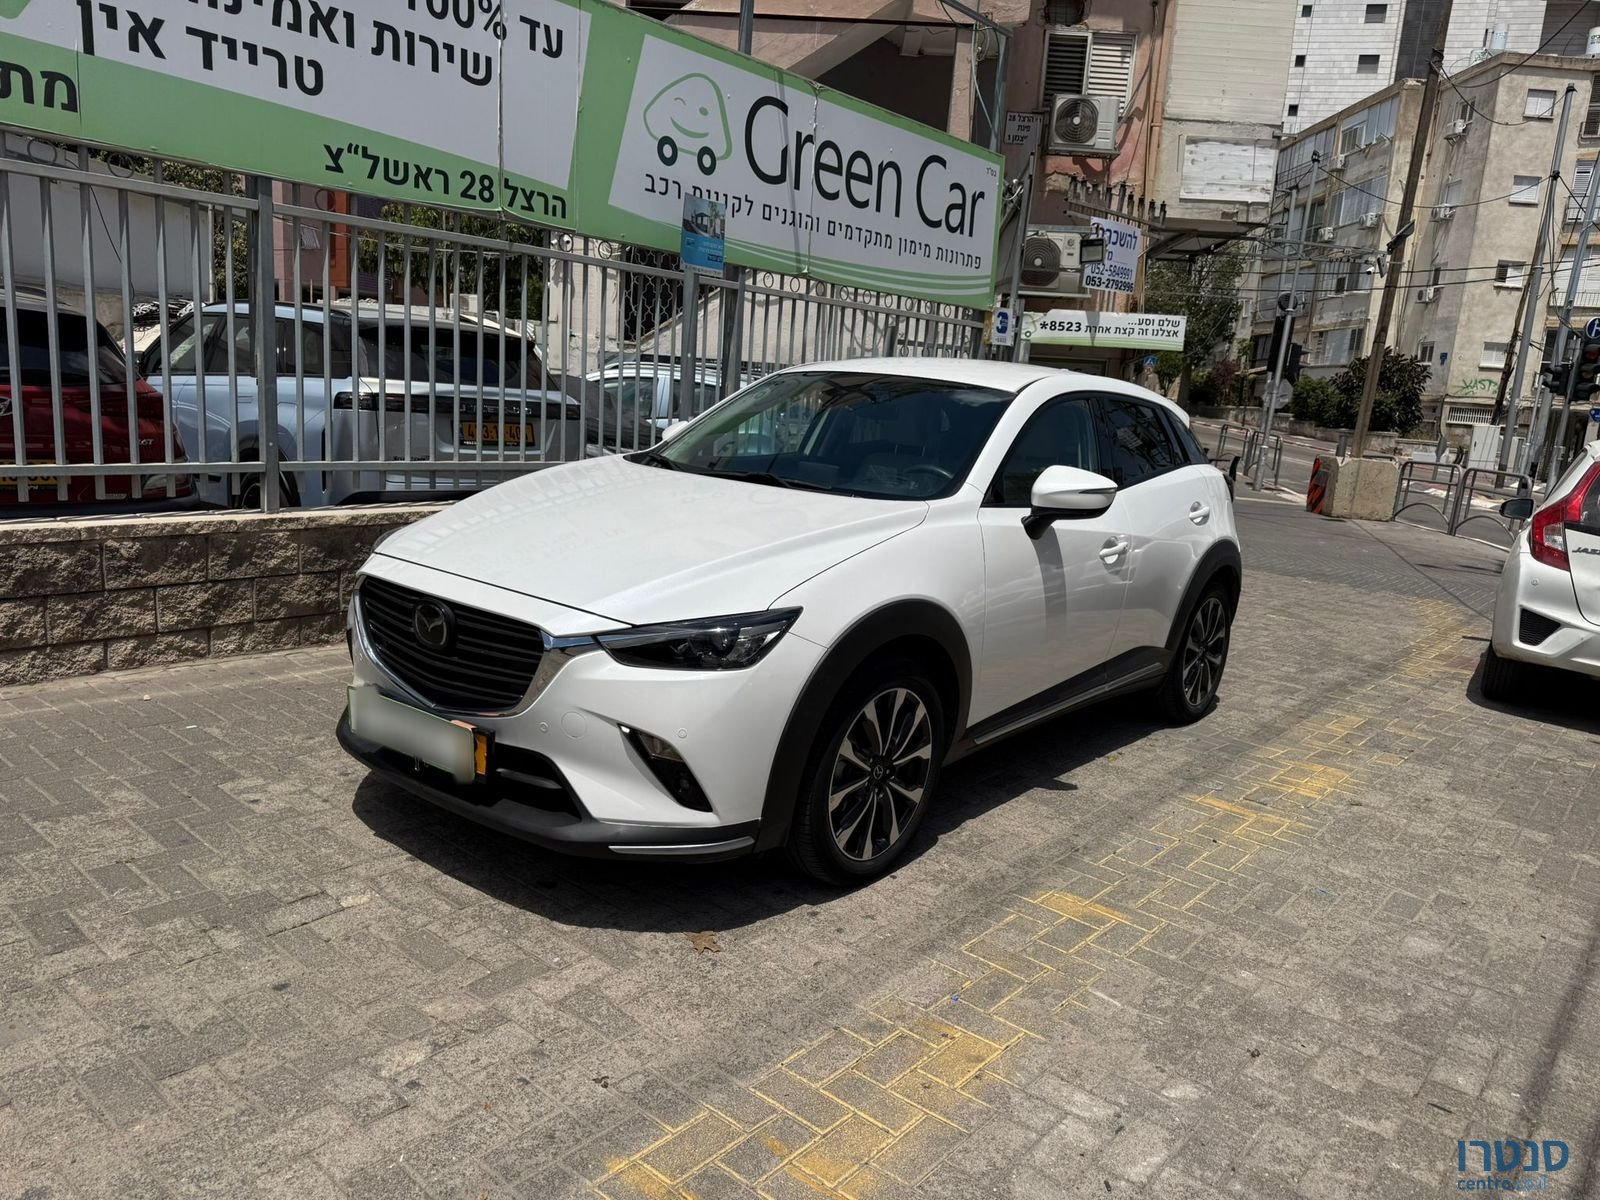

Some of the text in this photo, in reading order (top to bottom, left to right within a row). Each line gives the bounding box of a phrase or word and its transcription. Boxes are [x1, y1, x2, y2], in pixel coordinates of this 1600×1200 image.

[76, 0, 167, 60] אין
[519, 15, 563, 59] עד
[185, 26, 324, 96] טרייד
[371, 20, 492, 86] שירות
[744, 95, 985, 238] Green Car
[459, 169, 495, 203] 28
[503, 177, 567, 219] הרצל
[644, 173, 682, 199] רכב
[762, 203, 820, 233] והוגנים
[827, 219, 893, 249] מתקדמים
[898, 237, 931, 257] מימון
[935, 246, 982, 269] פתרונות
[1084, 324, 1112, 334] אחרת
[1113, 326, 1135, 337] קצת
[1137, 327, 1148, 336] זה
[1151, 327, 1179, 338] אצלנו
[1157, 317, 1180, 328] שלם
